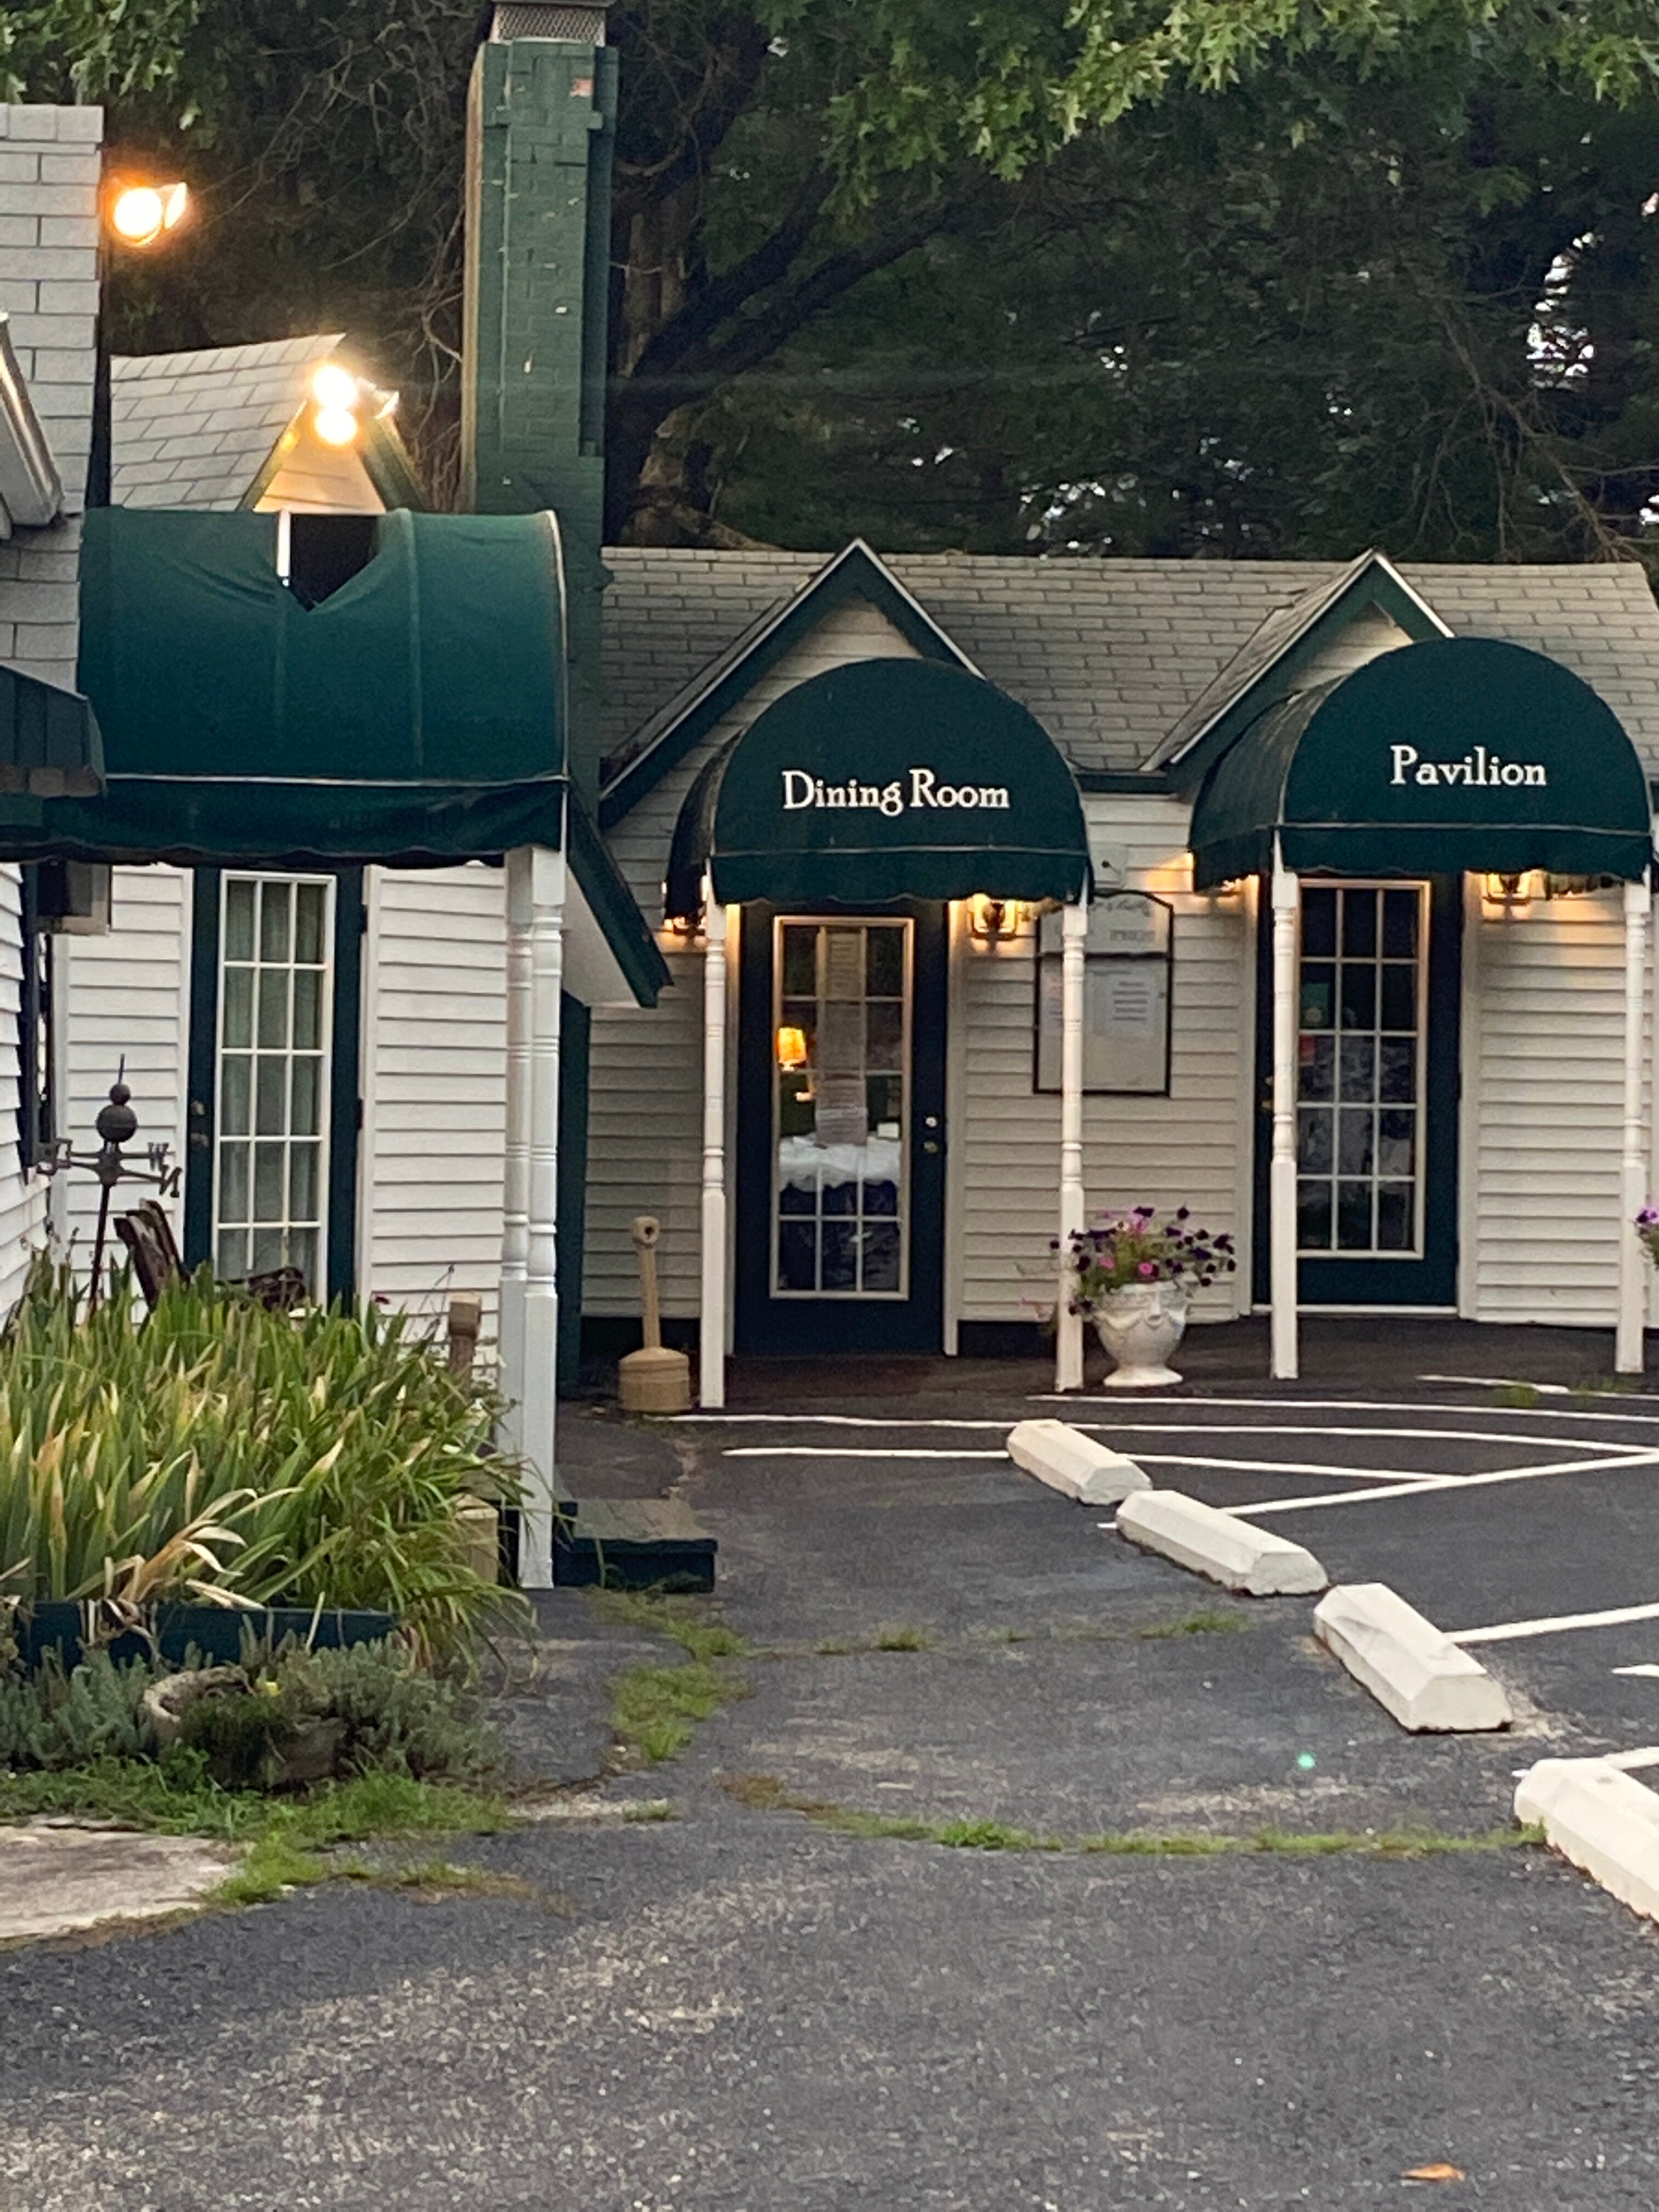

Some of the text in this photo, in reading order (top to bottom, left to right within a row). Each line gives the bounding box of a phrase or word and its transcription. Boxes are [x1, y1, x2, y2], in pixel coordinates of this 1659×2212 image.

[1390, 744, 1547, 786] Pavilion
[781, 768, 1010, 816] Dining Room
